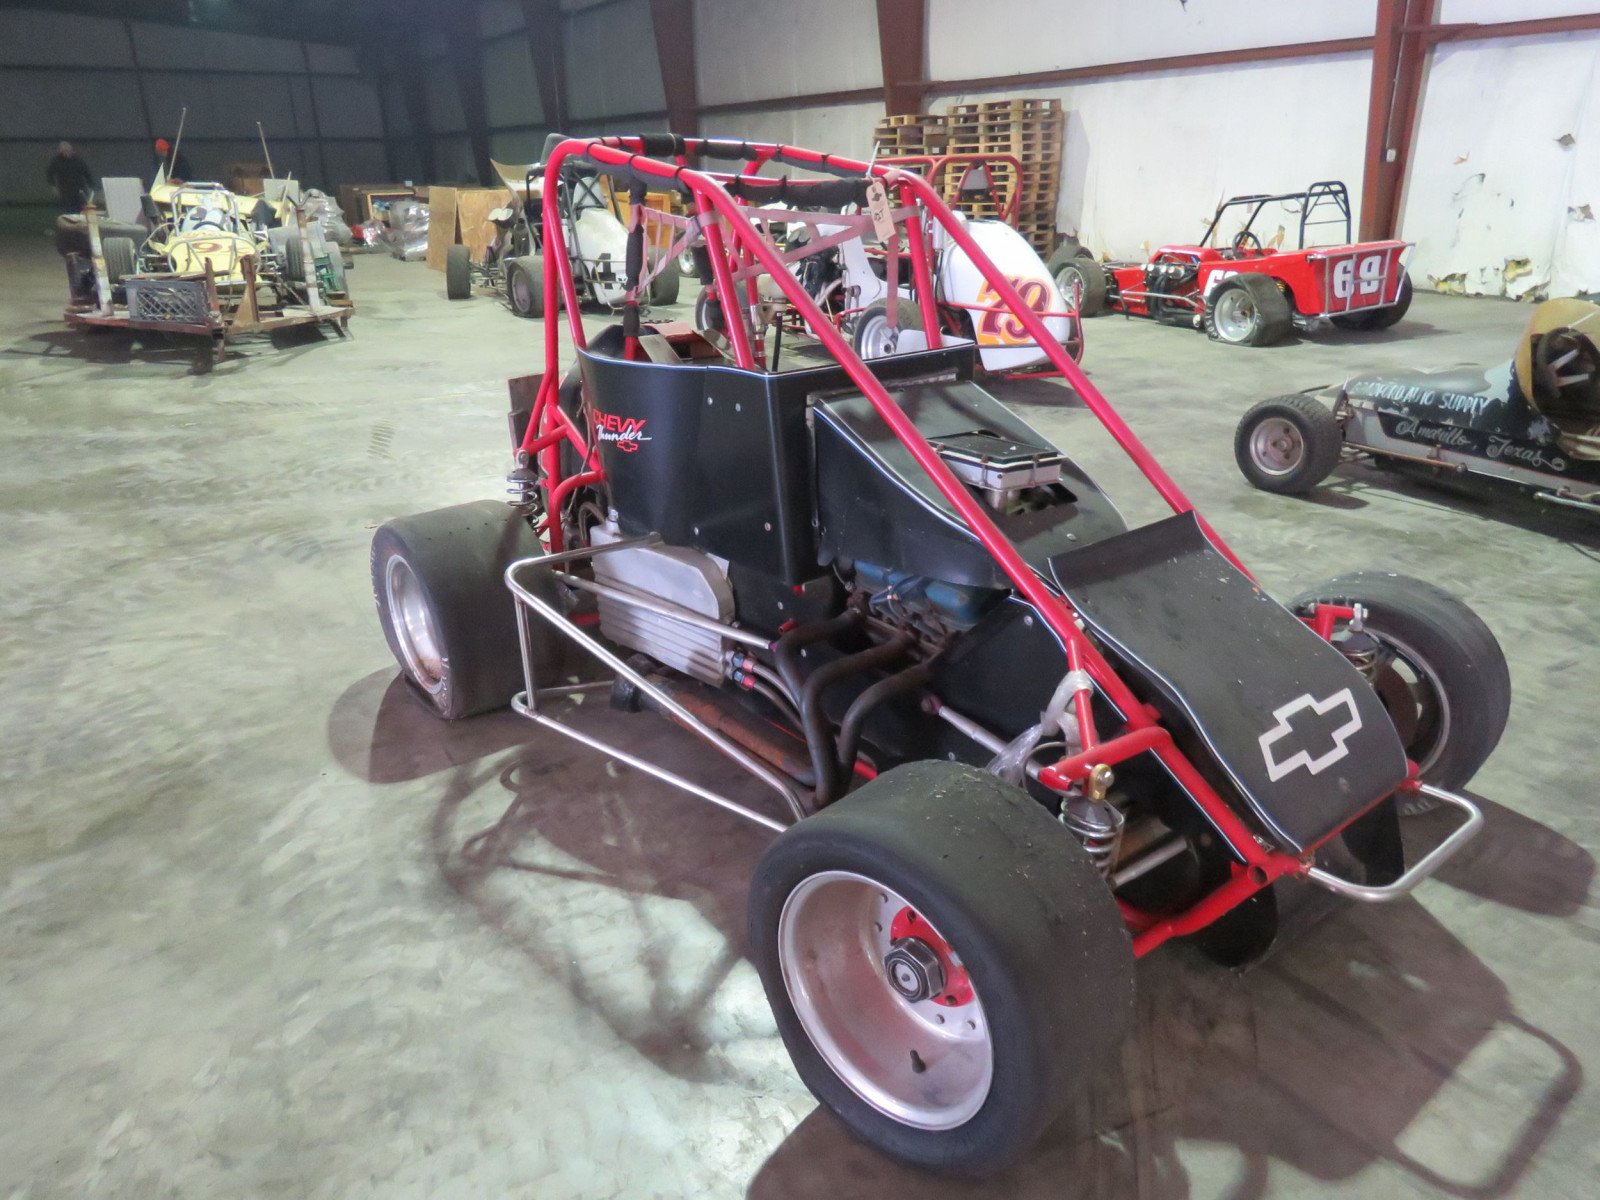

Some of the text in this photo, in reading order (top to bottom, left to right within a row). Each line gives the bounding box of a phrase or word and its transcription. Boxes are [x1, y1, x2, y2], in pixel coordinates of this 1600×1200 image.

[1333, 255, 1382, 299] 69
[1438, 392, 1491, 417] SUPPLY
[593, 408, 646, 432] CHEVY
[596, 424, 652, 441] Thunder
[1486, 435, 1565, 472] Texas
